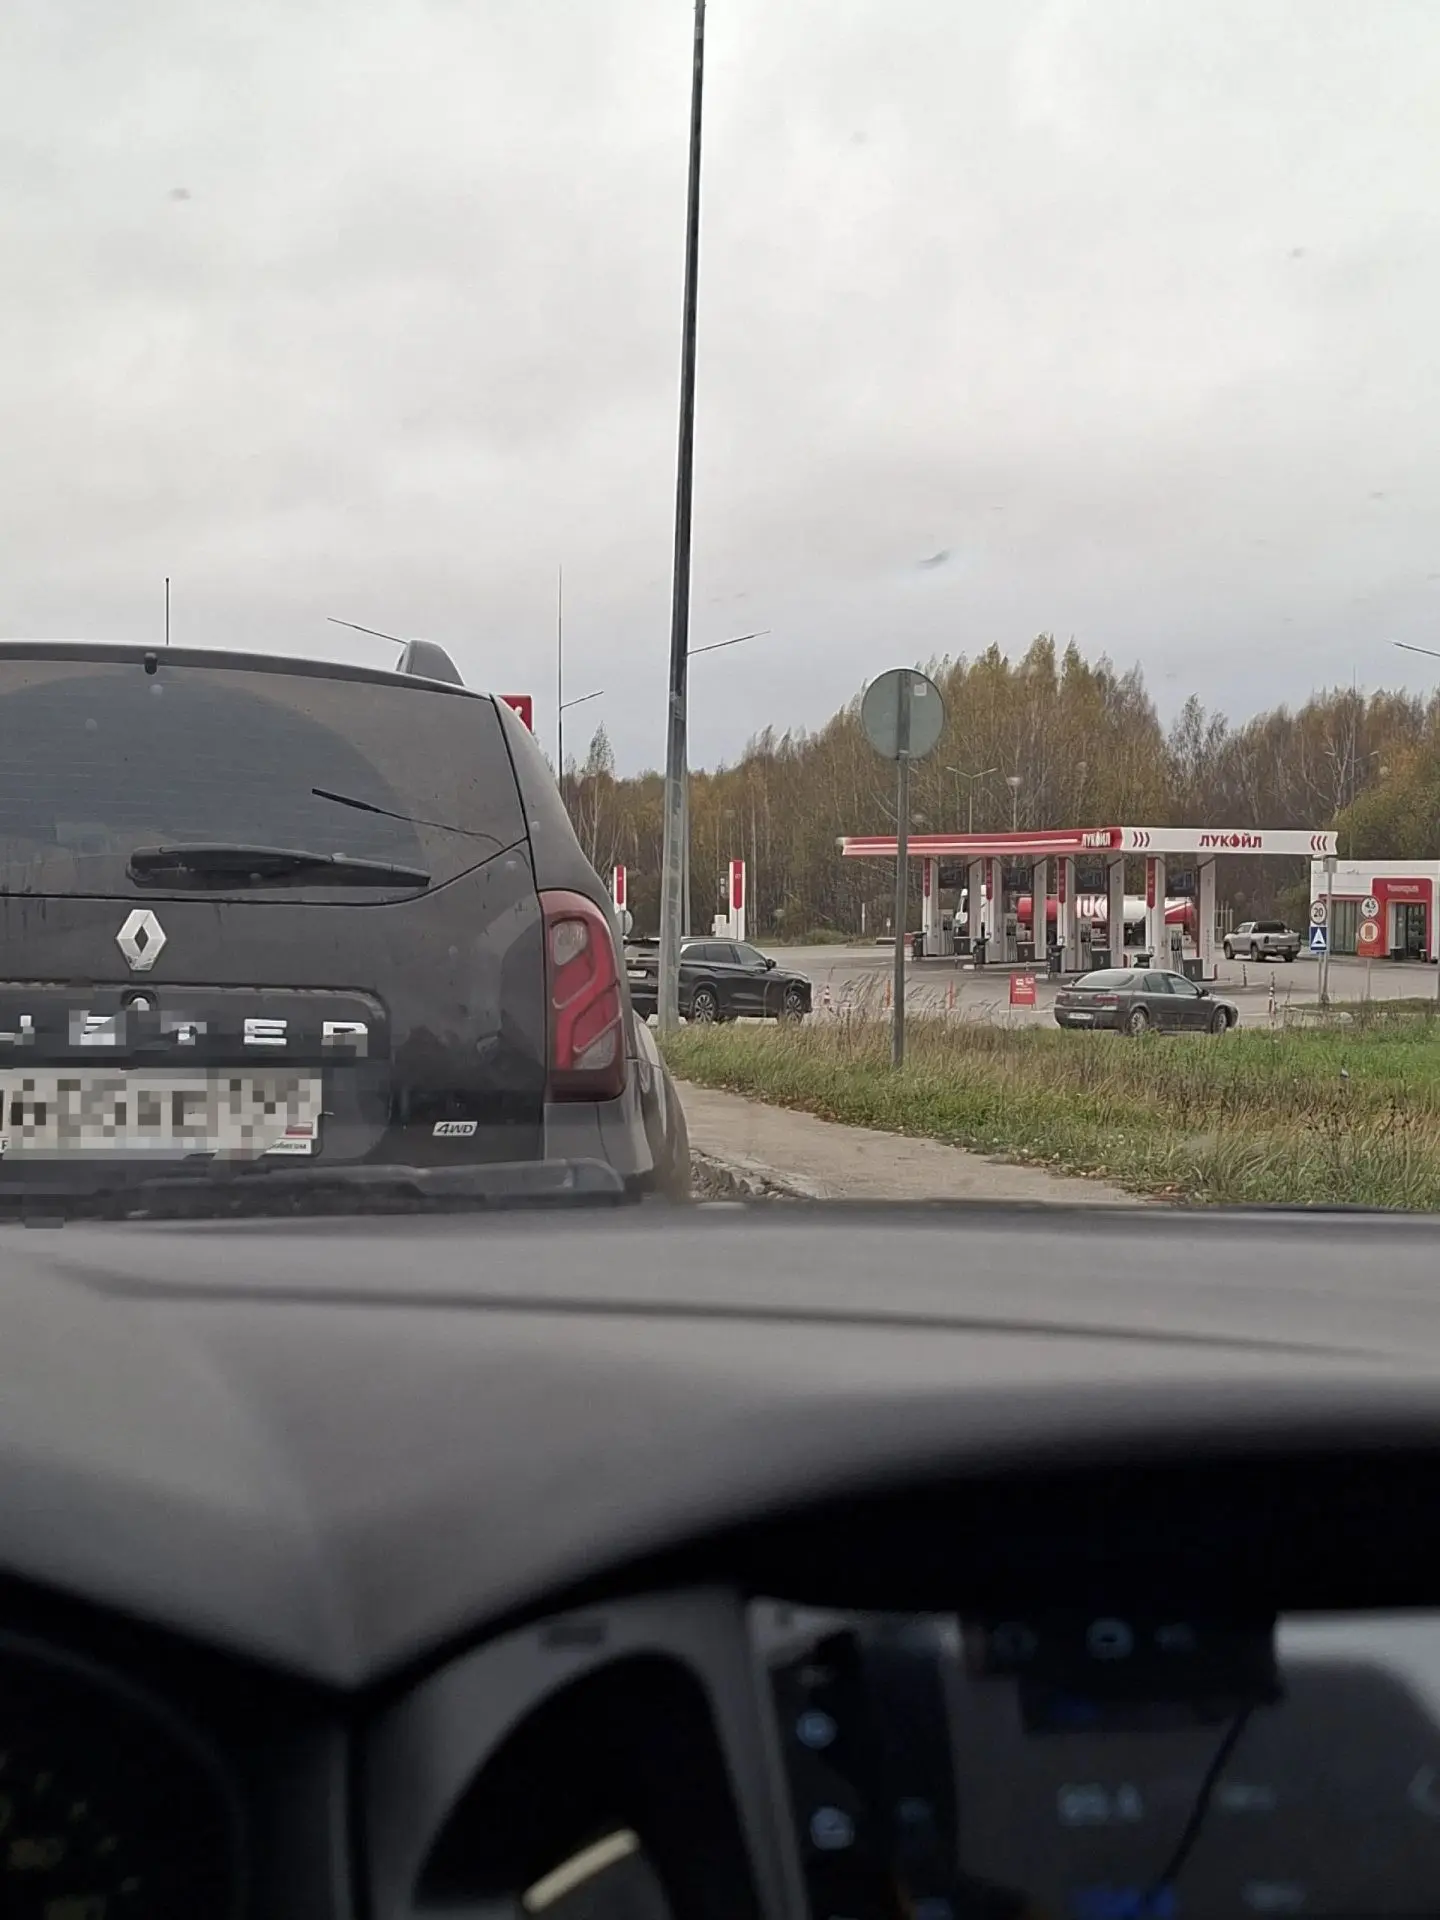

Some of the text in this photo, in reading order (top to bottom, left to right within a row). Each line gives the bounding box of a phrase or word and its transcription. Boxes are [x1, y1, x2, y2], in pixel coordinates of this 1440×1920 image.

[1199, 832, 1262, 848] ЛУКОЙЛ
[1313, 907, 1324, 918] 20
[434, 1122, 475, 1135] 4WD
